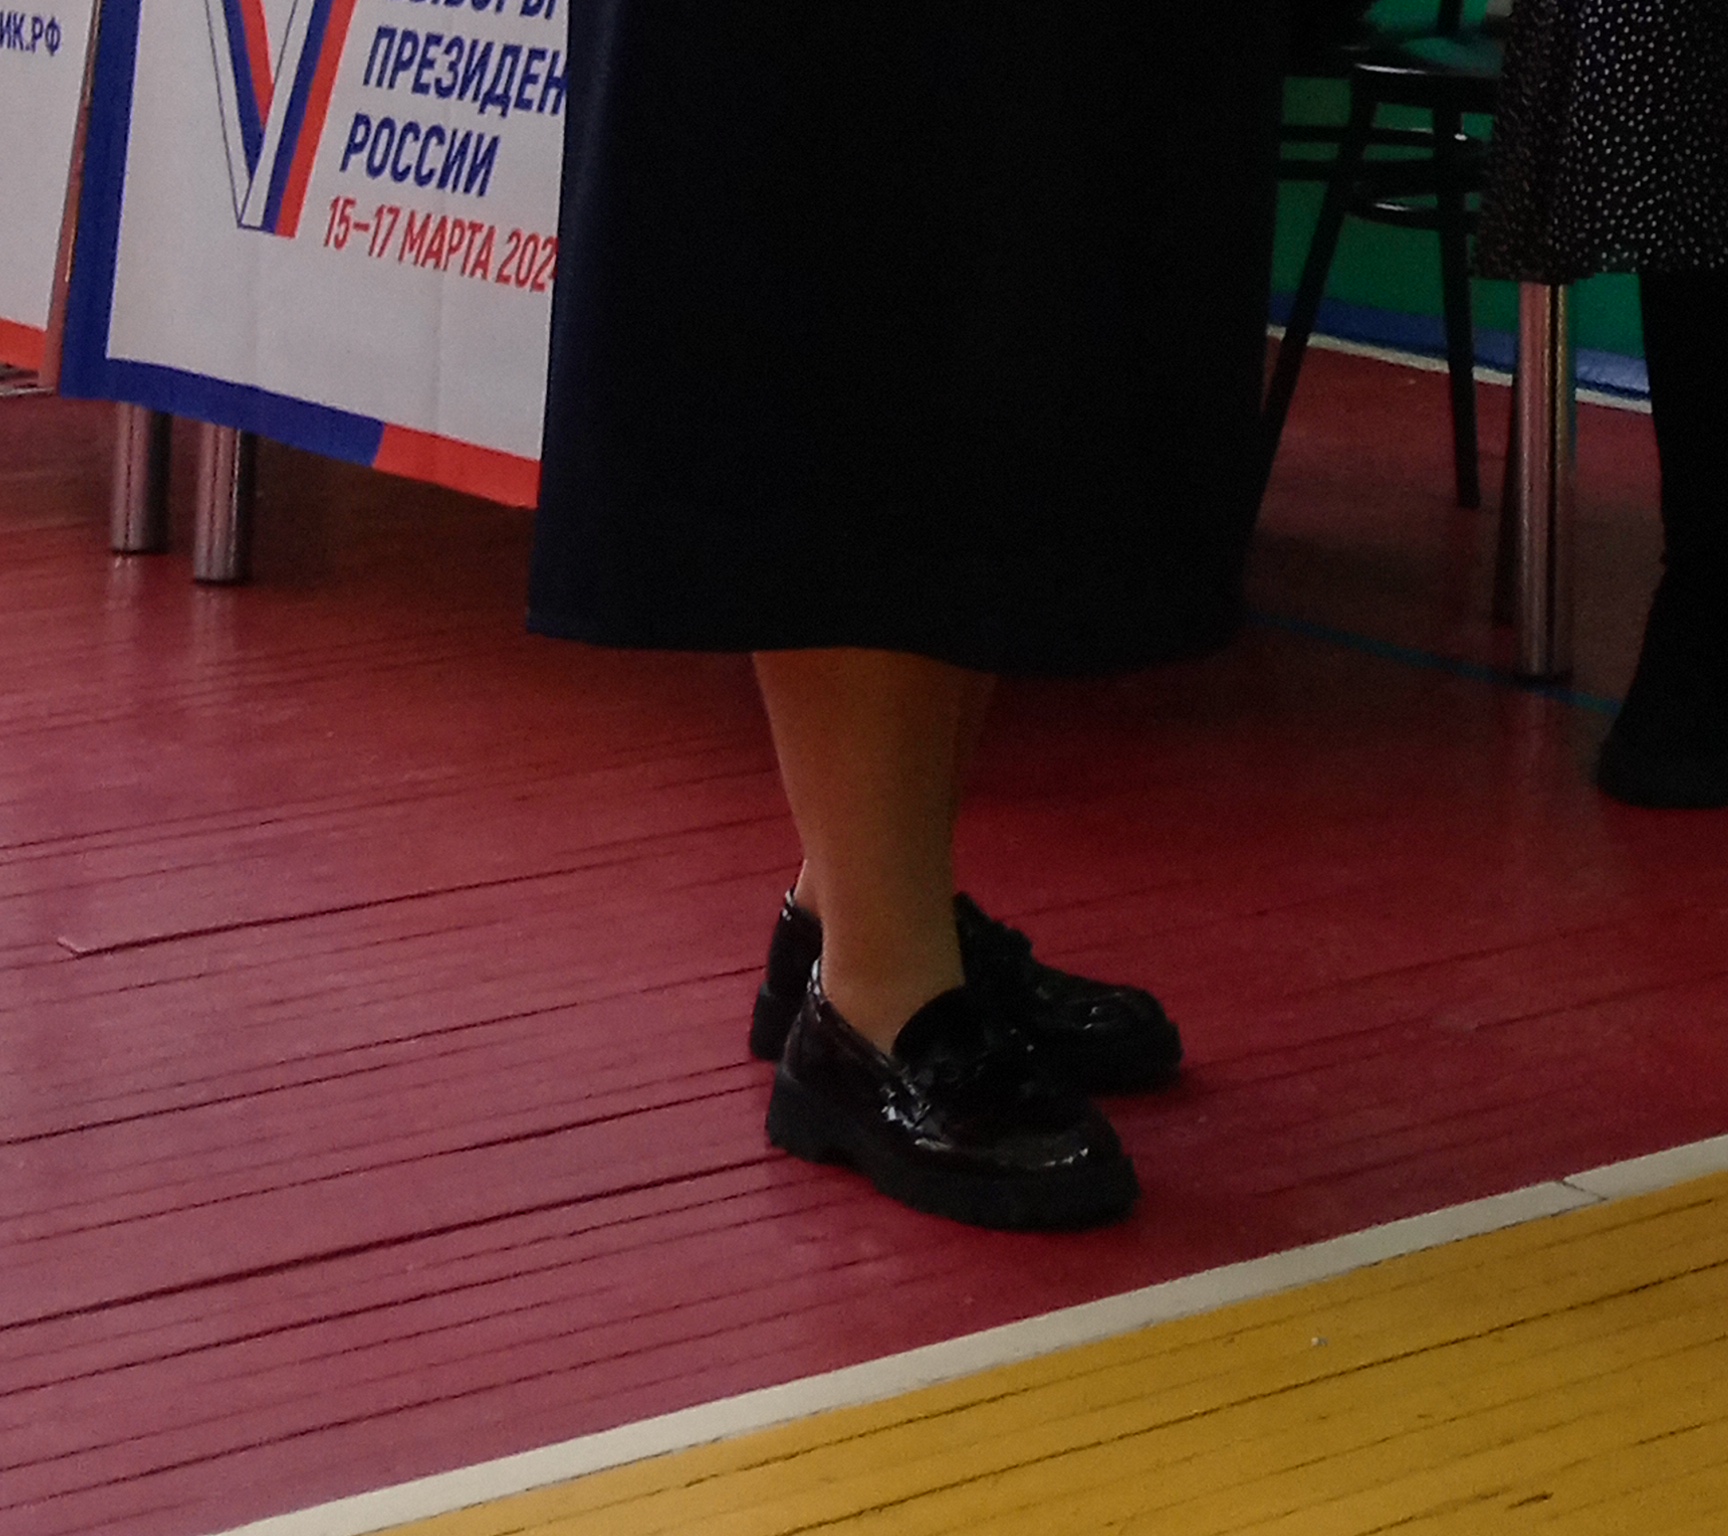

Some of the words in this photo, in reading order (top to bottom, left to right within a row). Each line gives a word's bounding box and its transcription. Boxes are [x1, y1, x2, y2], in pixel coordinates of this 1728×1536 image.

[362, 24, 569, 118] ПРЕЗИДЕН
[339, 112, 500, 198] РОССИИ
[398, 209, 496, 284] МАРТА
[495, 227, 559, 293] 202
